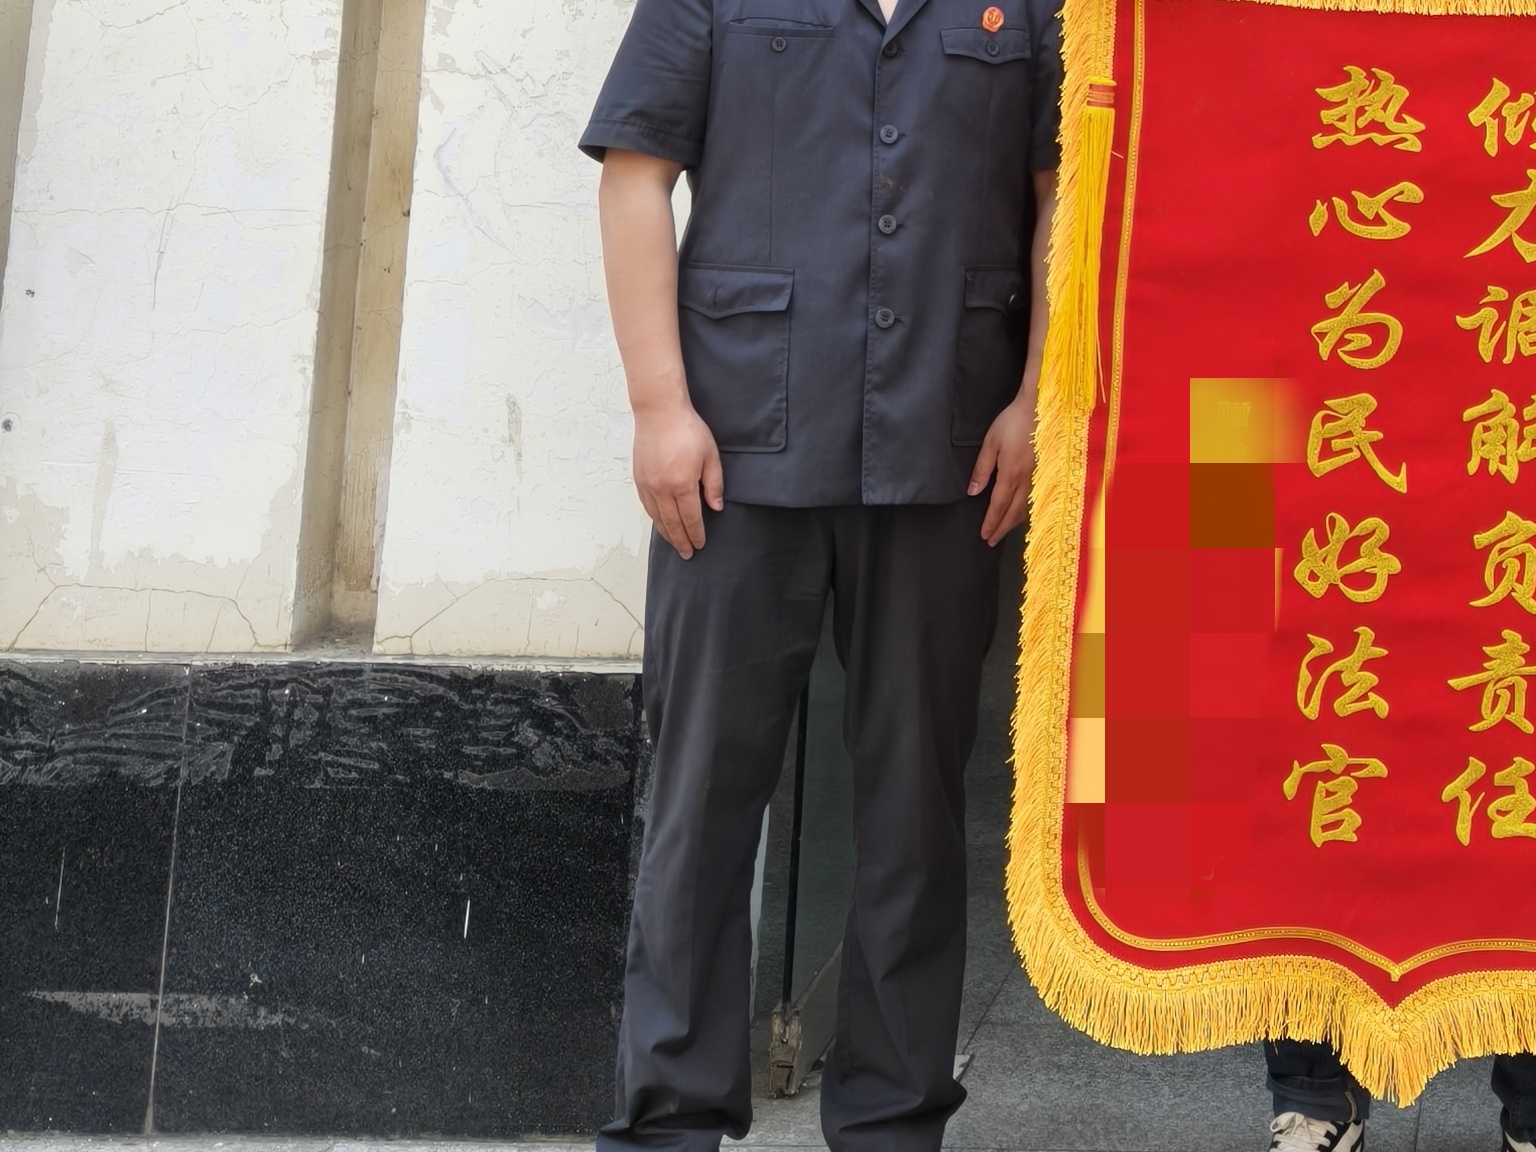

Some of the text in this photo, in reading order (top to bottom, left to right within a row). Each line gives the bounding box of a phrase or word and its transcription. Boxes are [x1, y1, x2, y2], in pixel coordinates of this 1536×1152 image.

[1282, 65, 1426, 848] 热心为民好法官
